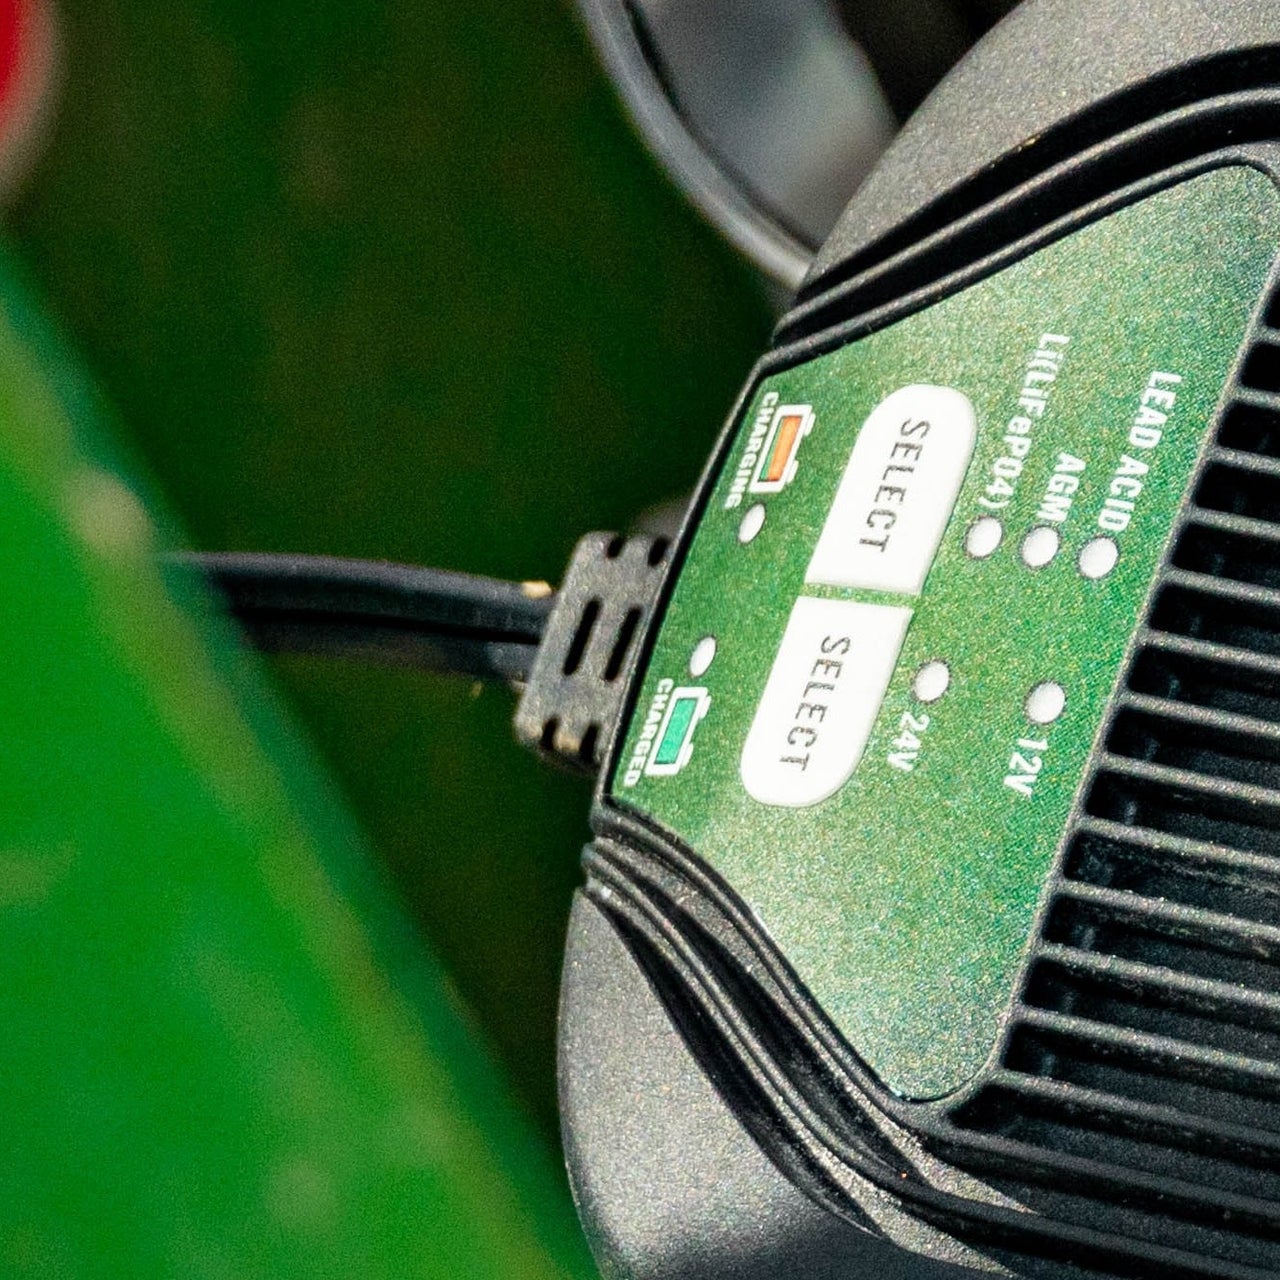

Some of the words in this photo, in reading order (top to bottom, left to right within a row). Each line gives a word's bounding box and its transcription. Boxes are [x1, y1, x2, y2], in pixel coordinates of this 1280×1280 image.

[1129, 370, 1182, 450] LEAD
[724, 391, 780, 510] CHARGING
[858, 417, 931, 553] SELECT
[1036, 451, 1087, 522] AGM
[1097, 453, 1150, 532] ACID
[623, 677, 675, 787] CHARGED
[779, 635, 851, 772] SELECT
[886, 711, 930, 771] 24V
[1003, 738, 1049, 798] 12V
